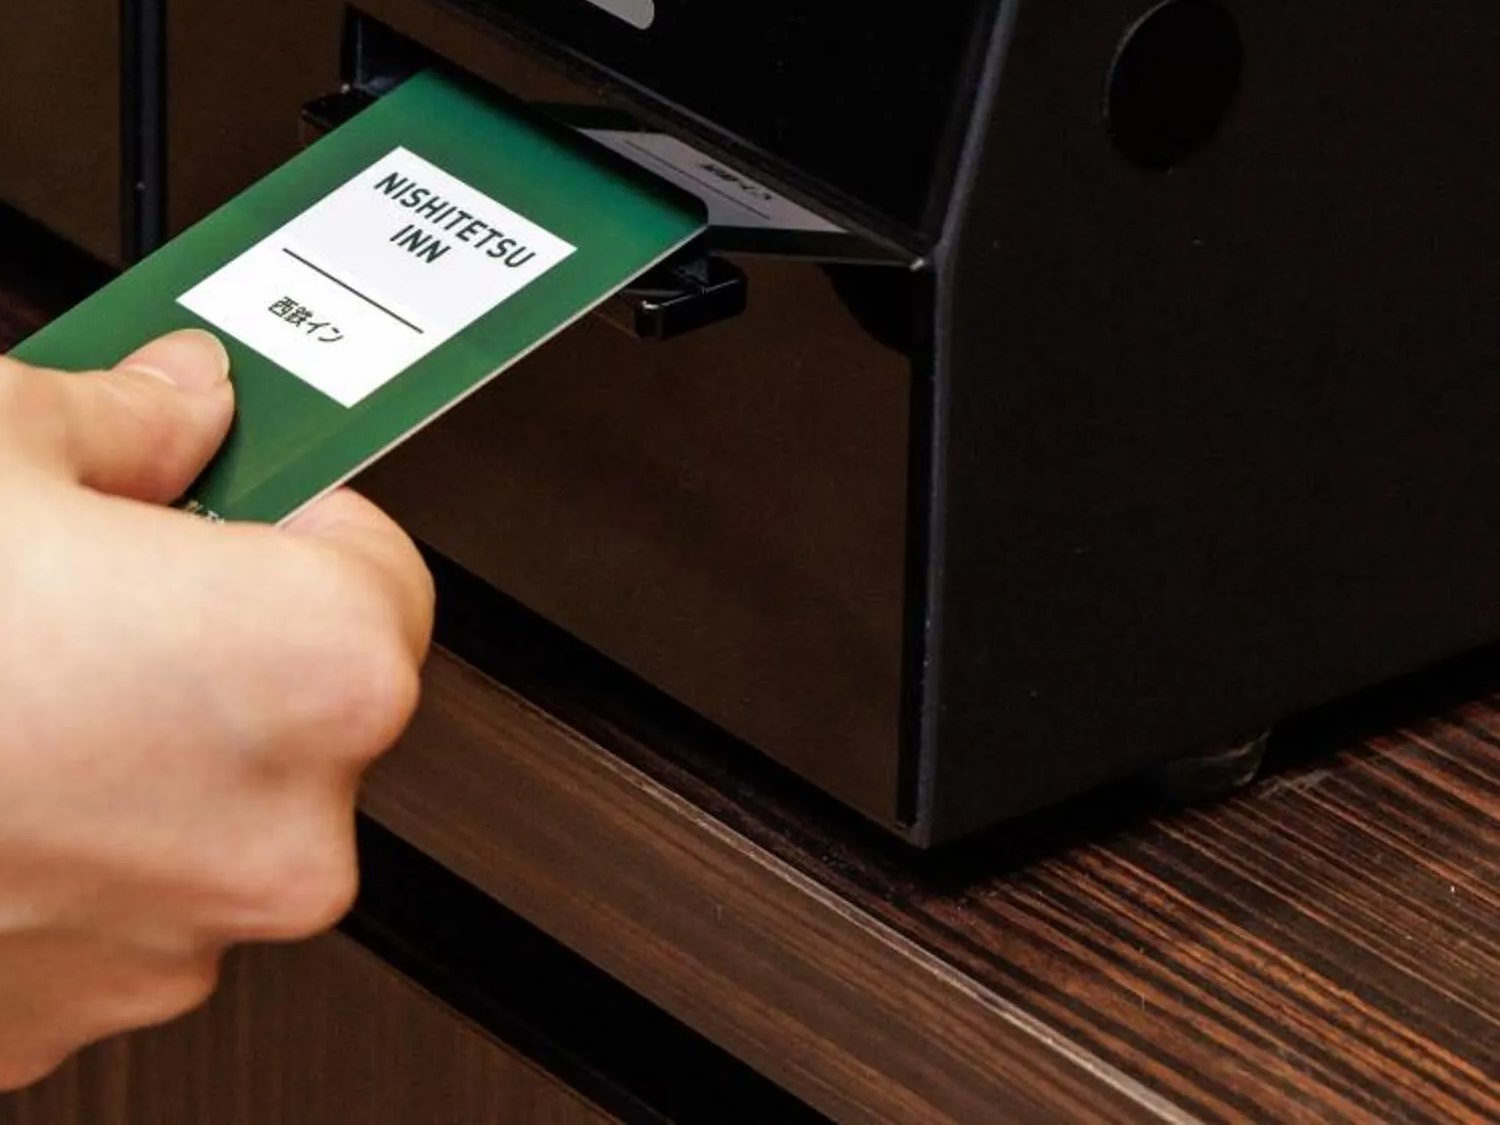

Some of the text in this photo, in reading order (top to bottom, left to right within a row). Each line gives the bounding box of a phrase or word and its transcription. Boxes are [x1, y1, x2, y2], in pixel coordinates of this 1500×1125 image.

[373, 171, 537, 269] NISHITETSU
[389, 224, 452, 264] INN
[267, 295, 344, 343] 西鉄イン
